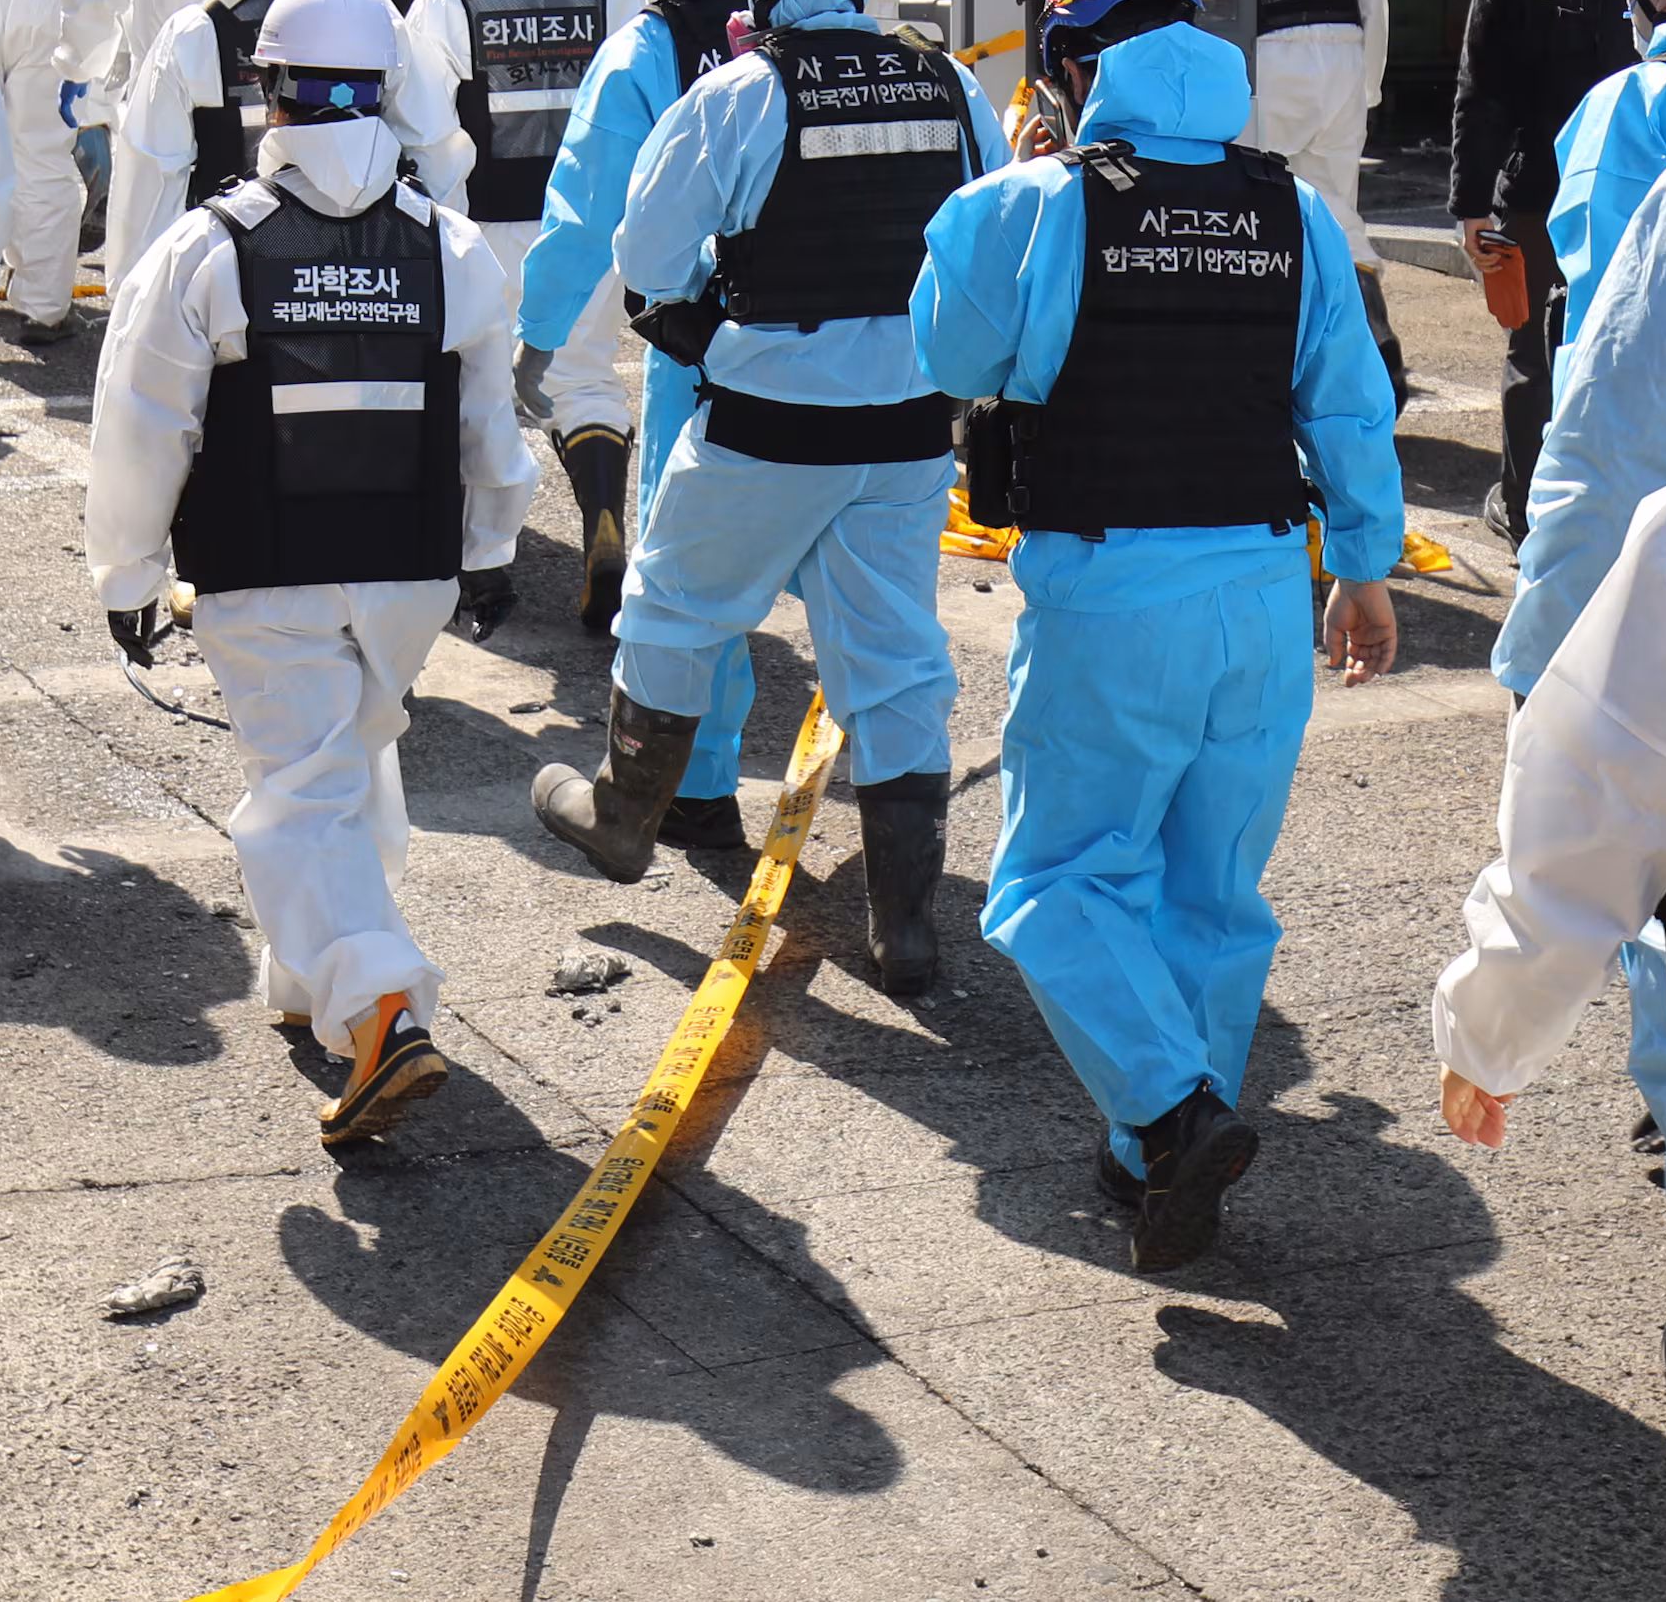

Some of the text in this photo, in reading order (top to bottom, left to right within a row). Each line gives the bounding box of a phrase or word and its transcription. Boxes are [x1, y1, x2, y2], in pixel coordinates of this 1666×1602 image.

[482, 14, 595, 46] 화재조사
[1139, 206, 1261, 240] 사고조사
[1101, 246, 1293, 278] 한국전기안전공사
[293, 265, 401, 299] 과학조사
[272, 301, 421, 324] 국립재난안전연구원
